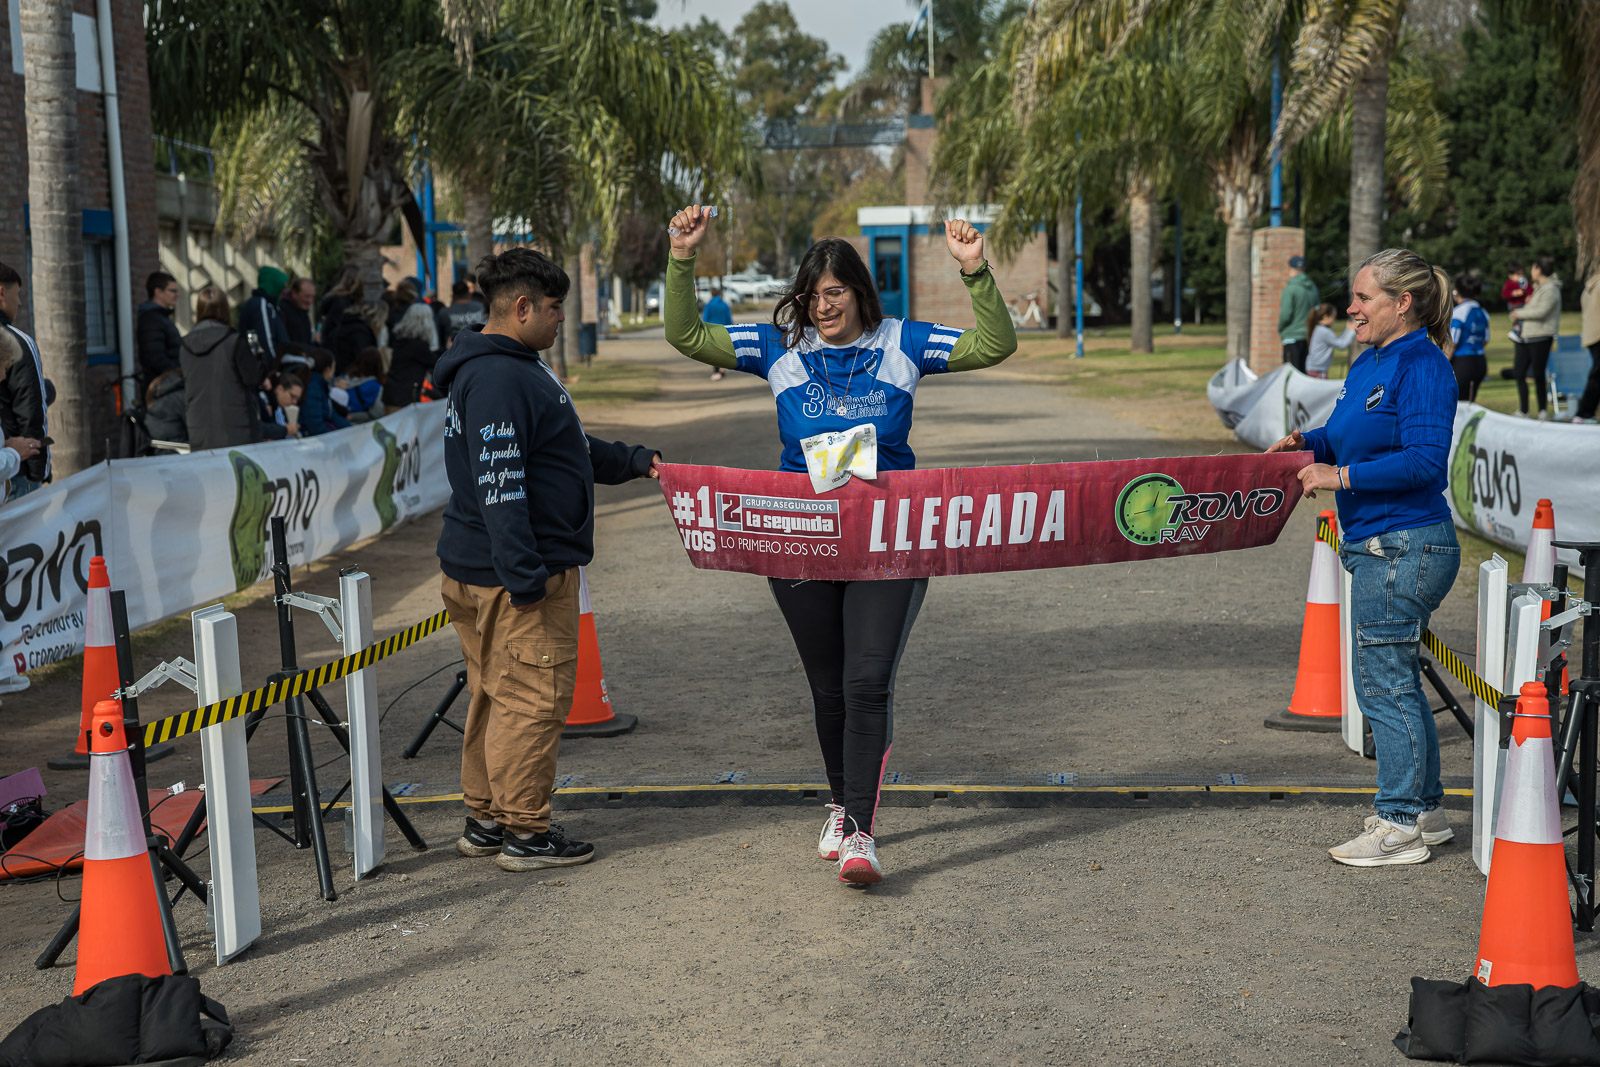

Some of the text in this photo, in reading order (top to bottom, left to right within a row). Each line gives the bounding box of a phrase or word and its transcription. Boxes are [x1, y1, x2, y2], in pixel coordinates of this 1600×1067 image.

[803, 383, 825, 418] 3
[826, 389, 886, 411] MARATÓN
[479, 423, 495, 442] El
[479, 443, 521, 467] de pueblo
[478, 467, 526, 488] más grand
[485, 488, 499, 506] del
[672, 485, 715, 528] #1
[745, 498, 833, 512] GRUPO ASEGURADOR
[745, 510, 834, 534] la segunda
[869, 489, 1065, 552] LLEGADA
[680, 528, 717, 552] VOS
[1159, 524, 1211, 544] RAV
[720, 536, 839, 557] LO PRIMERO SOS VOS
[28, 641, 77, 669] cronorav
